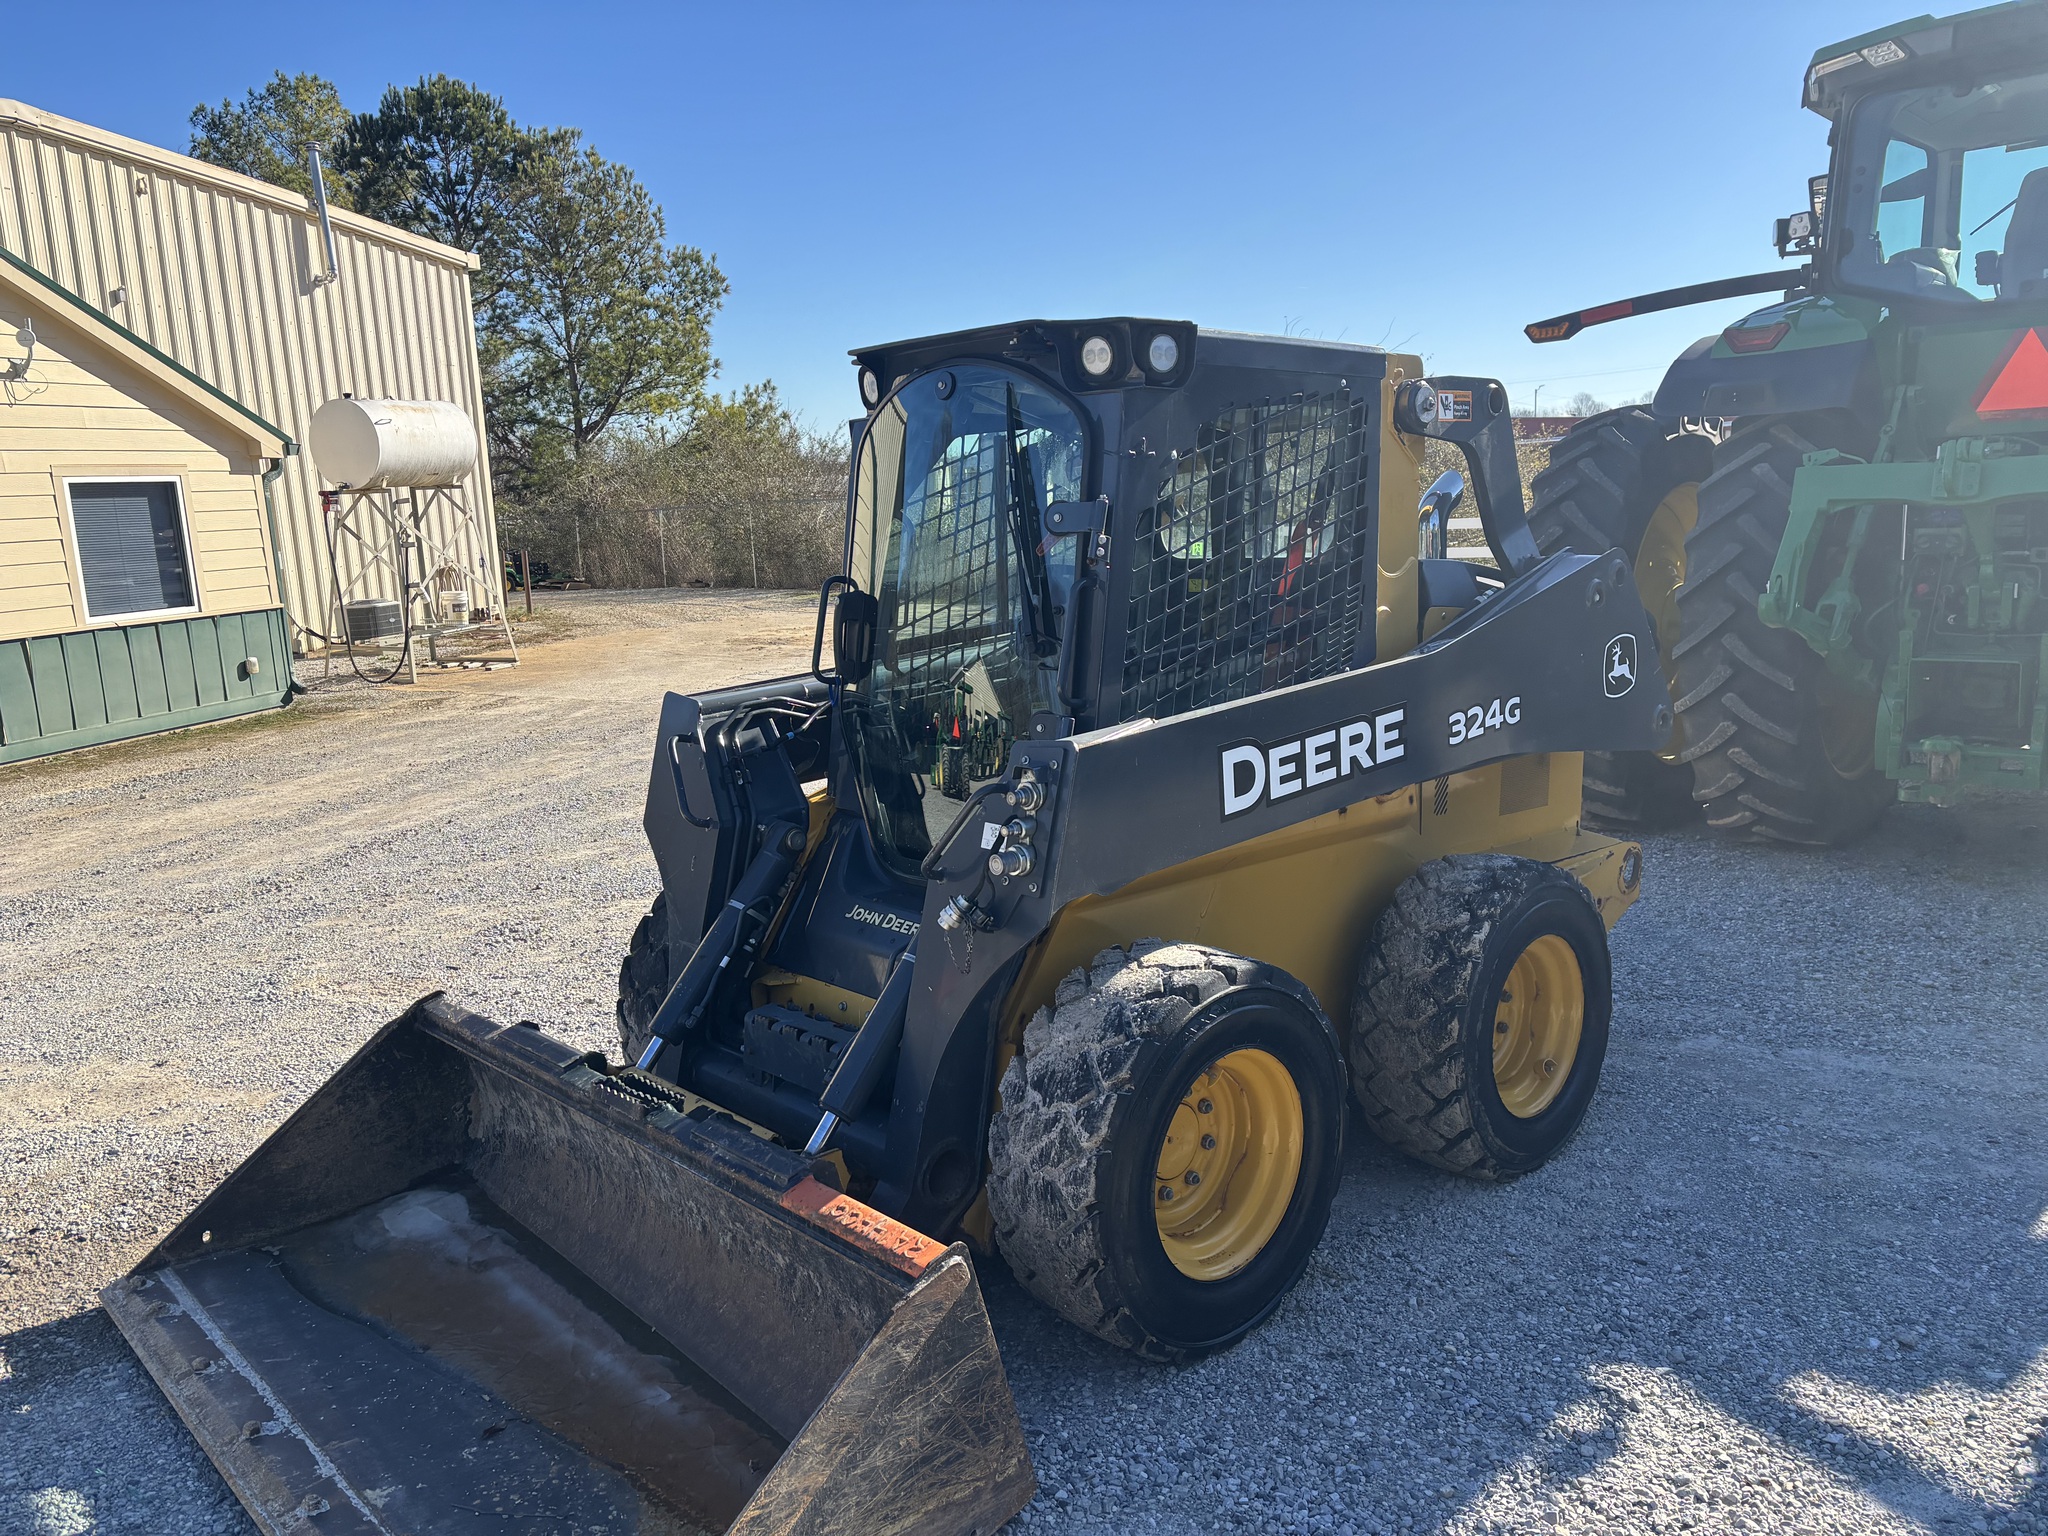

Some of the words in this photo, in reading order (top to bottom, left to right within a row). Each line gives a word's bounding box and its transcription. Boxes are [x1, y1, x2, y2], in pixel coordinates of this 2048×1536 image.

[1448, 696, 1521, 745] 324G
[1221, 709, 1405, 816] DEERE
[844, 904, 885, 926] JOHN
[882, 913, 921, 936] DEER
